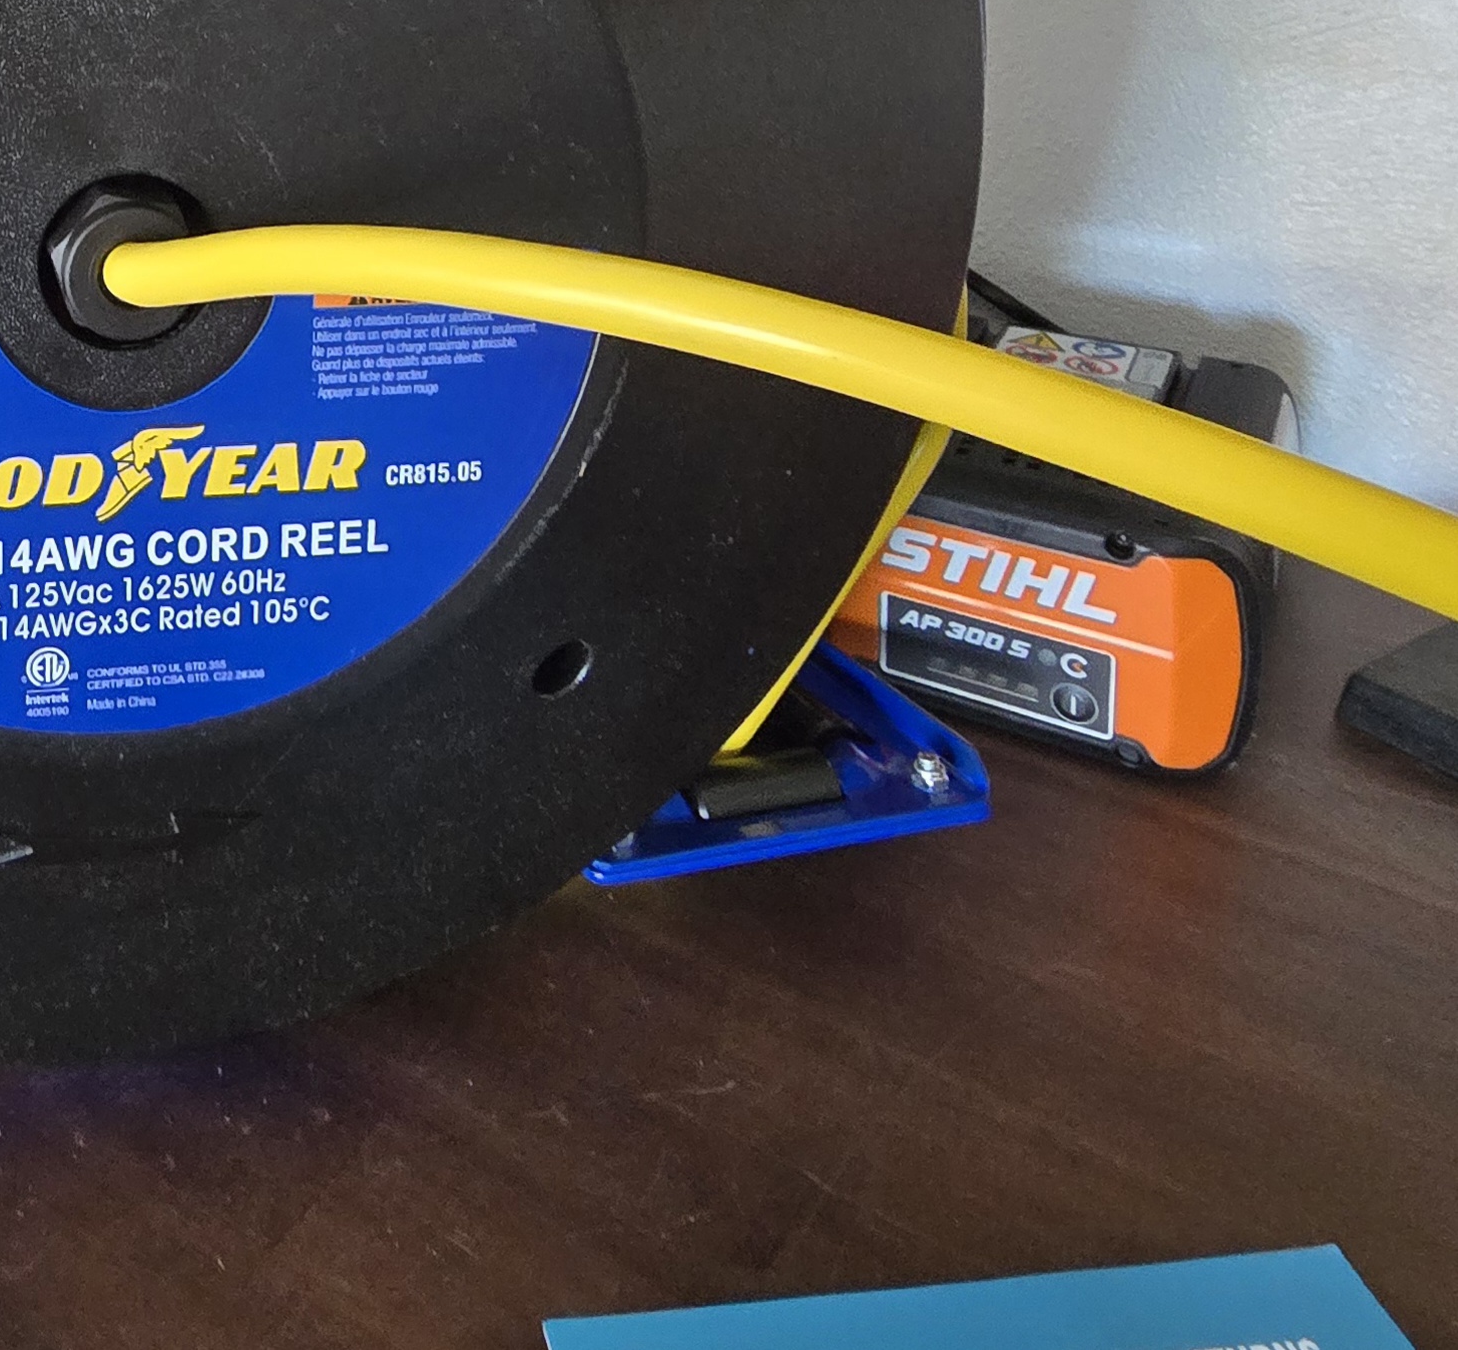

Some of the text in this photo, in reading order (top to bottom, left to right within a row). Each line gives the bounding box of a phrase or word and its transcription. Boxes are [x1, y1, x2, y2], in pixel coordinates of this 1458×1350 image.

[386, 461, 482, 486] CR815.05
[147, 525, 269, 566] CORD
[280, 518, 389, 558] REEL
[9, 580, 112, 609] 125Vac
[122, 572, 214, 602] 1625W
[221, 568, 286, 596] 60Hz
[881, 526, 1117, 624] STIHL
[159, 600, 241, 632] Rated
[251, 595, 330, 625] 105°C
[899, 610, 1032, 660] AP 300 S
[87, 665, 149, 678] CONFORMS
[152, 664, 167, 673] TO
[169, 663, 182, 672] UL
[87, 677, 144, 690] CERTIFIED
[146, 676, 161, 686] TO
[163, 675, 185, 684] CSA
[26, 692, 69, 706] Intertek
[87, 696, 156, 710] Made in China
